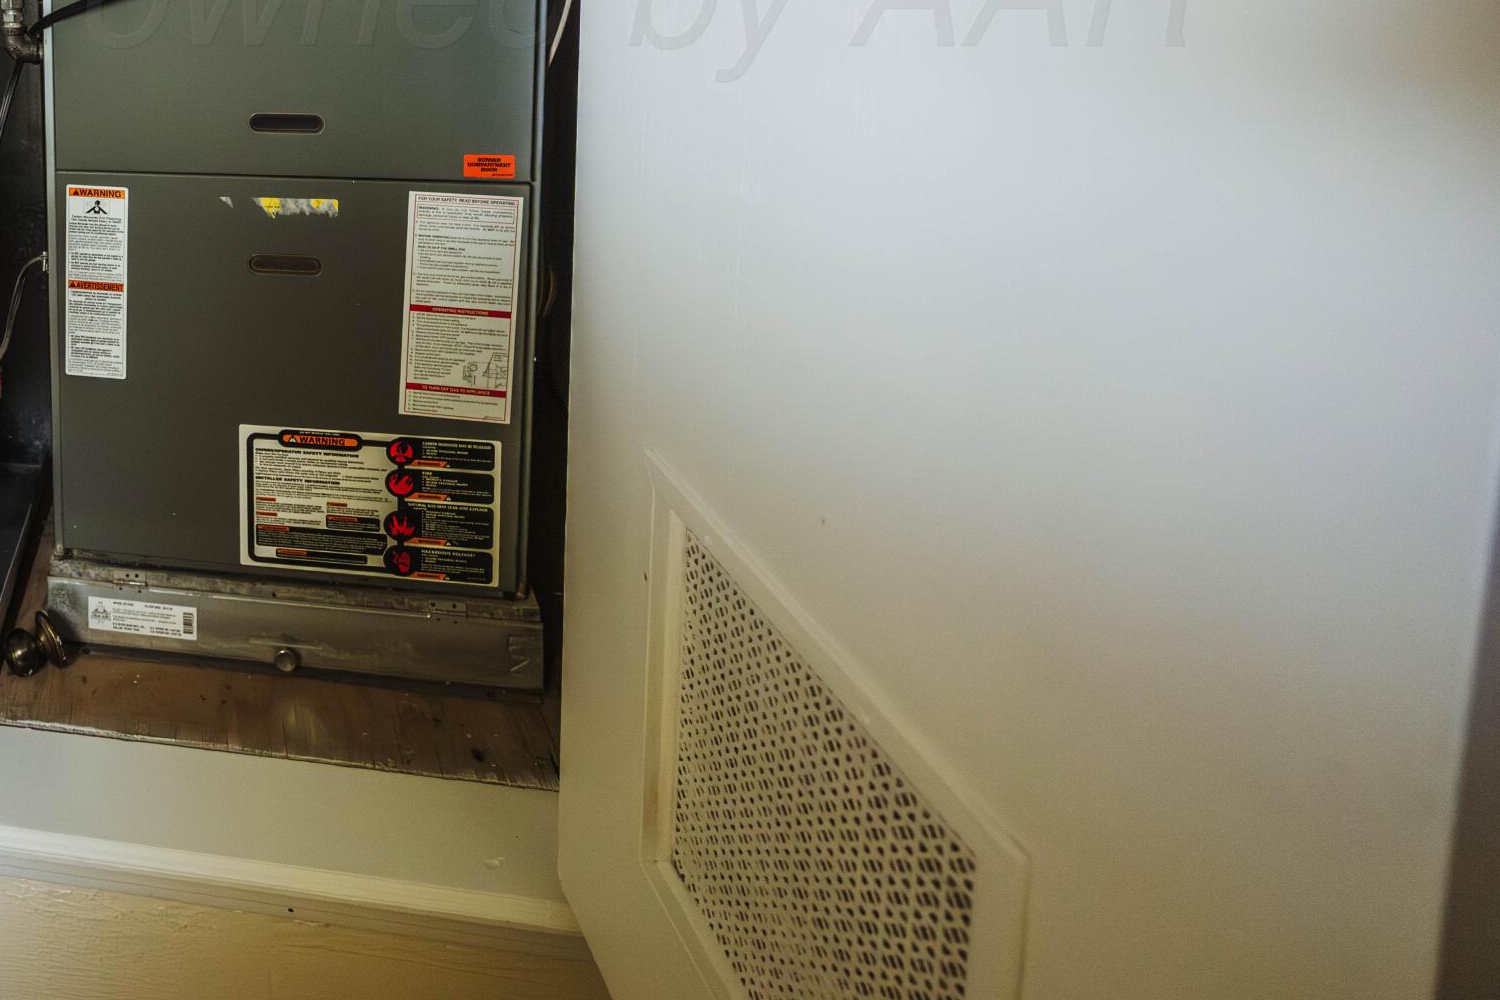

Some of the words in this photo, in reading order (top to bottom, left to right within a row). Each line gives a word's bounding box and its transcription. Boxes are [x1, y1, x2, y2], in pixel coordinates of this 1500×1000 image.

[80, 189, 122, 198] WARNING
[76, 281, 123, 292] AVERTISSEMENT
[300, 436, 345, 446] WARNING
